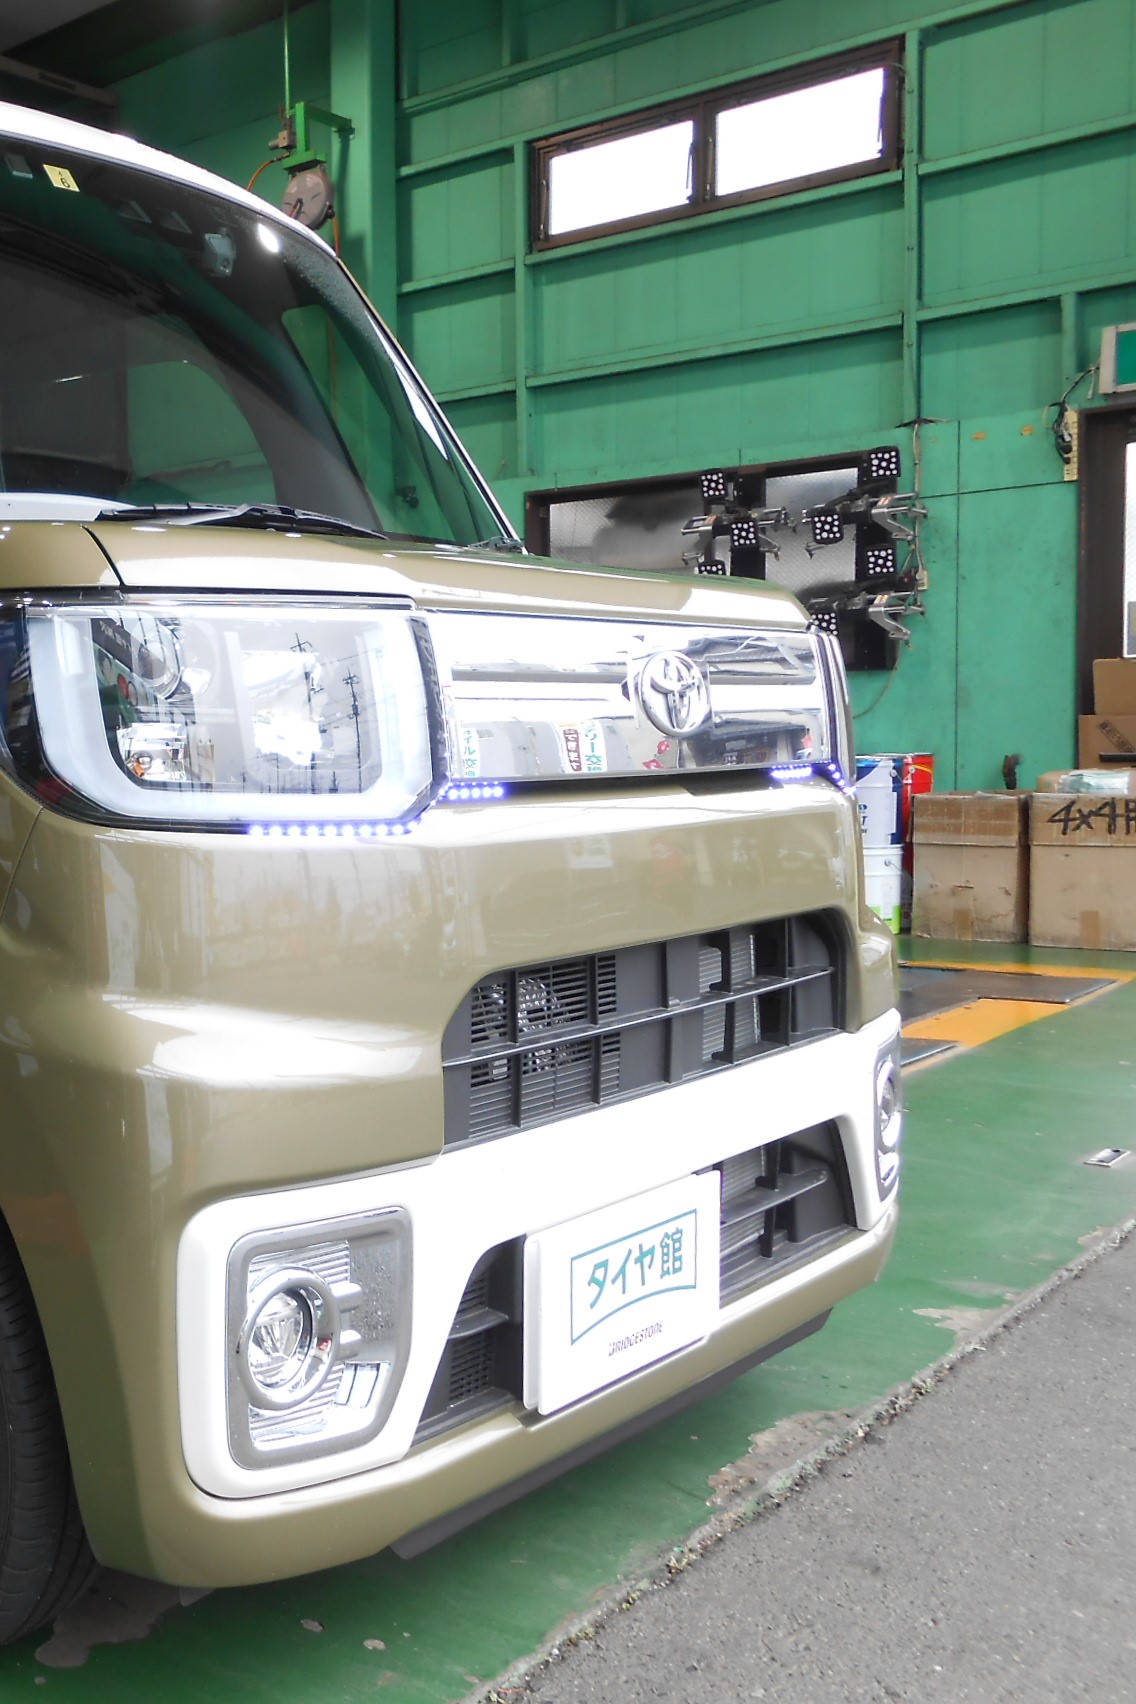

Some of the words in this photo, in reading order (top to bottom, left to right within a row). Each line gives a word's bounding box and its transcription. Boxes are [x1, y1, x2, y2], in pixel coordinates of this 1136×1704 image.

[586, 1226, 683, 1310] タイヤ館
[608, 1320, 664, 1357] BRIDGESTONE
